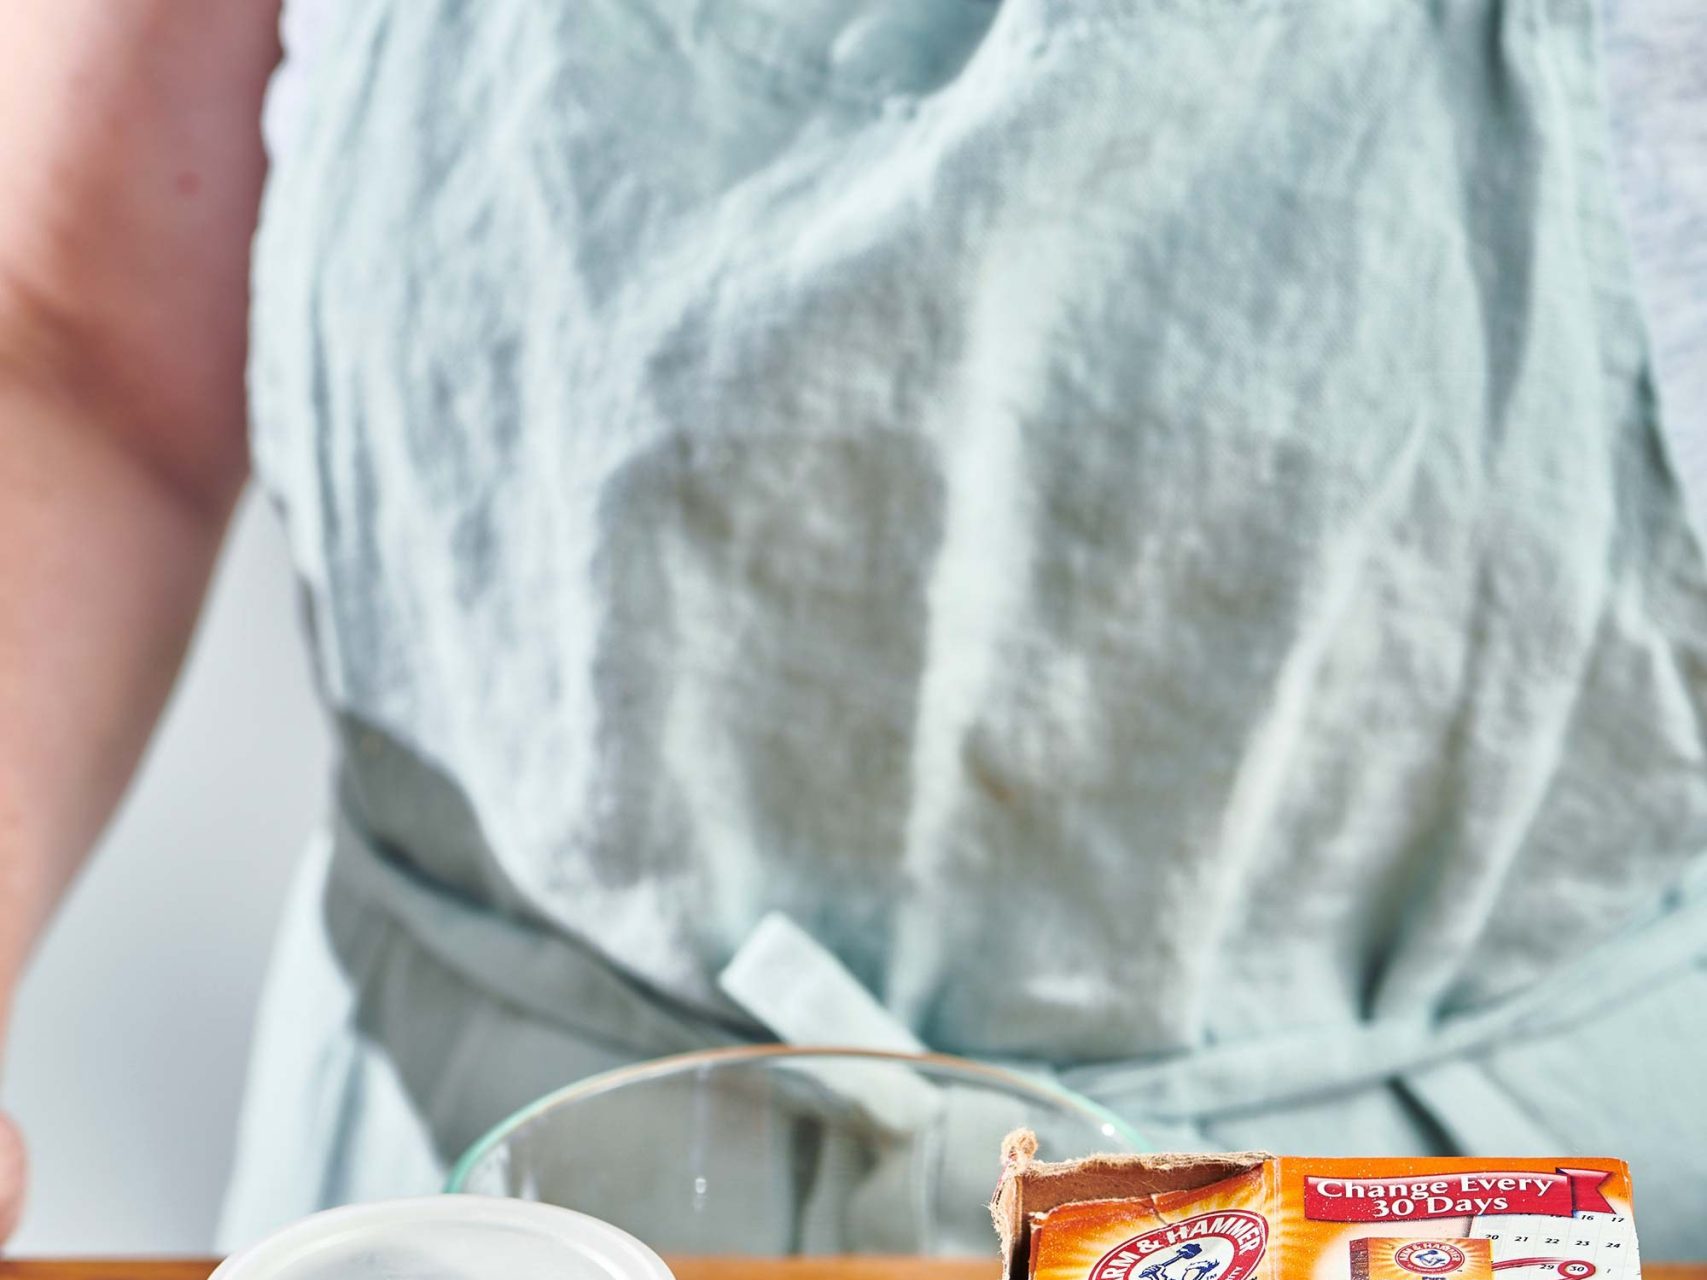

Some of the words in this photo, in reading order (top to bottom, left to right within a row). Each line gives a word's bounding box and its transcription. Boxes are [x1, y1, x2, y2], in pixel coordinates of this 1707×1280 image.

[1316, 1179, 1448, 1200] Change
[1460, 1175, 1555, 1196] Every
[1373, 1198, 1415, 1217] 30
[1426, 1196, 1509, 1215] Days
[1137, 1238, 1163, 1254] &
[1166, 1216, 1262, 1256] HAMMER
